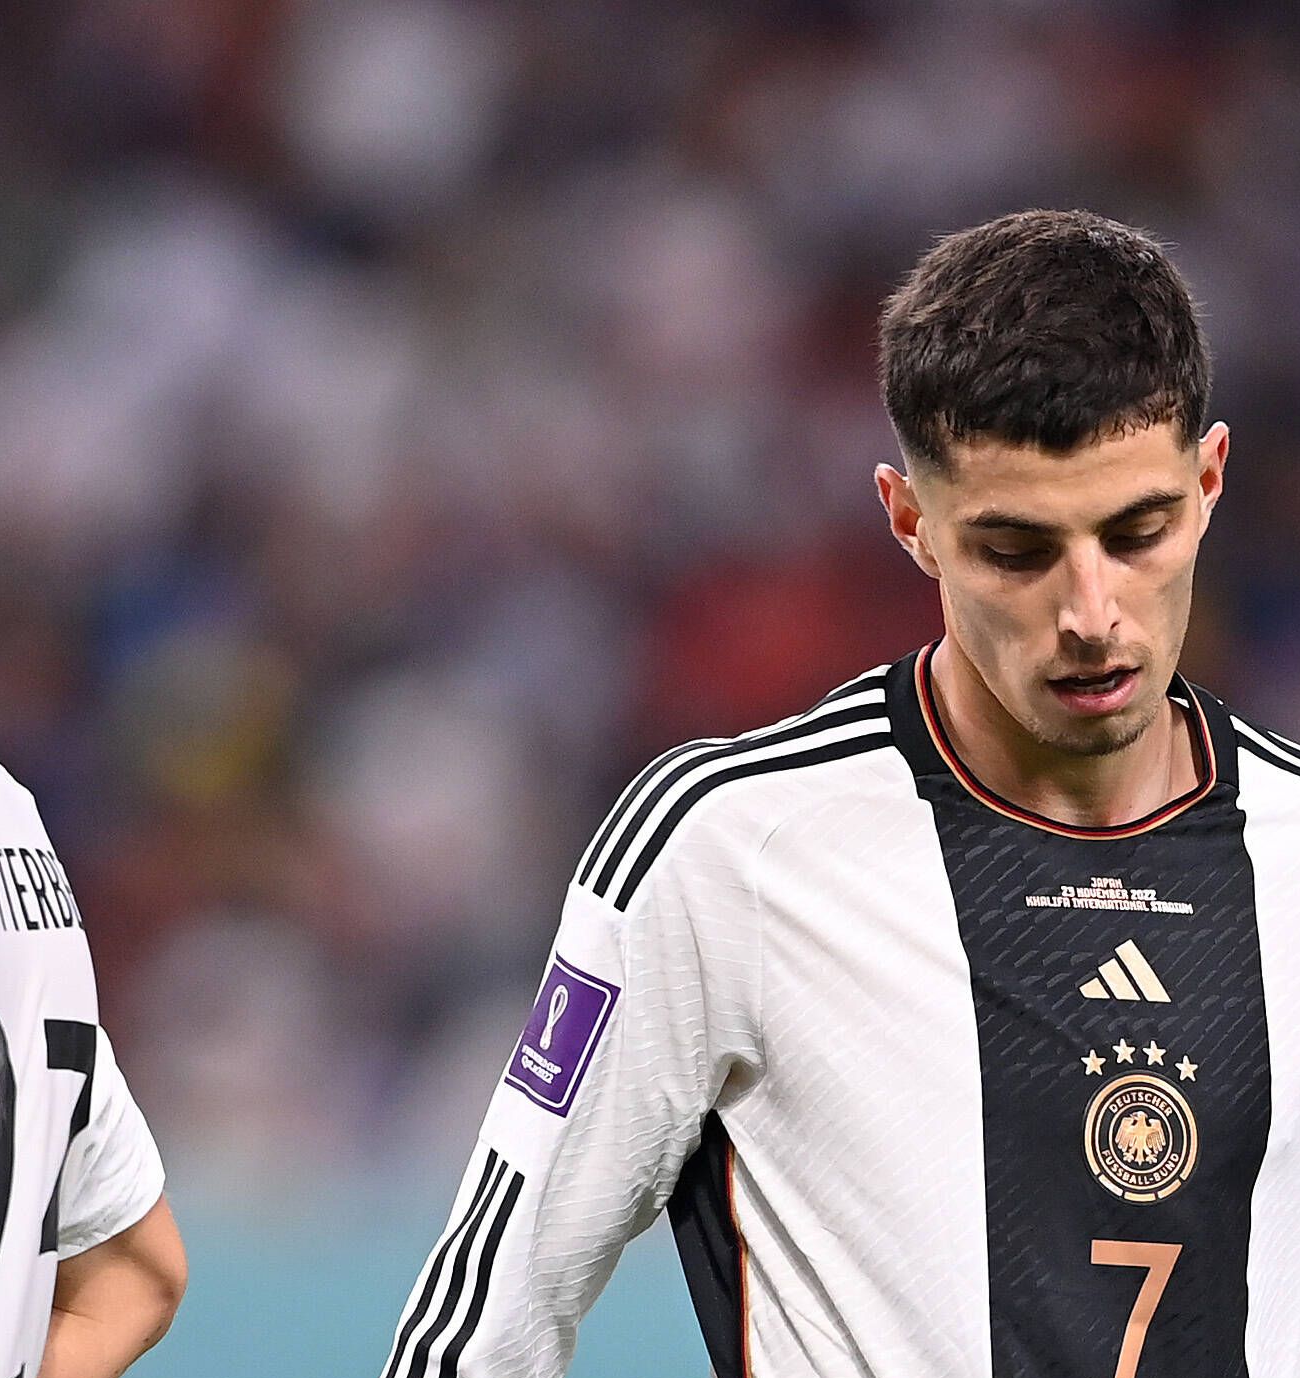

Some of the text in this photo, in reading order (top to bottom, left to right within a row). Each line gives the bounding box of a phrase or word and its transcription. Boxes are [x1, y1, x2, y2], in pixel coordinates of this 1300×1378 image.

[1091, 877, 1123, 889] JAPAN
[1076, 887, 1129, 900] NOVEMBER
[1130, 889, 1157, 900] 2022
[1025, 896, 1194, 914] KHALIFA INTERNATIONAL STADIUM
[1109, 1091, 1173, 1117] DEUTSCHER
[1102, 1150, 1180, 1185] FUSSBALL-BUND
